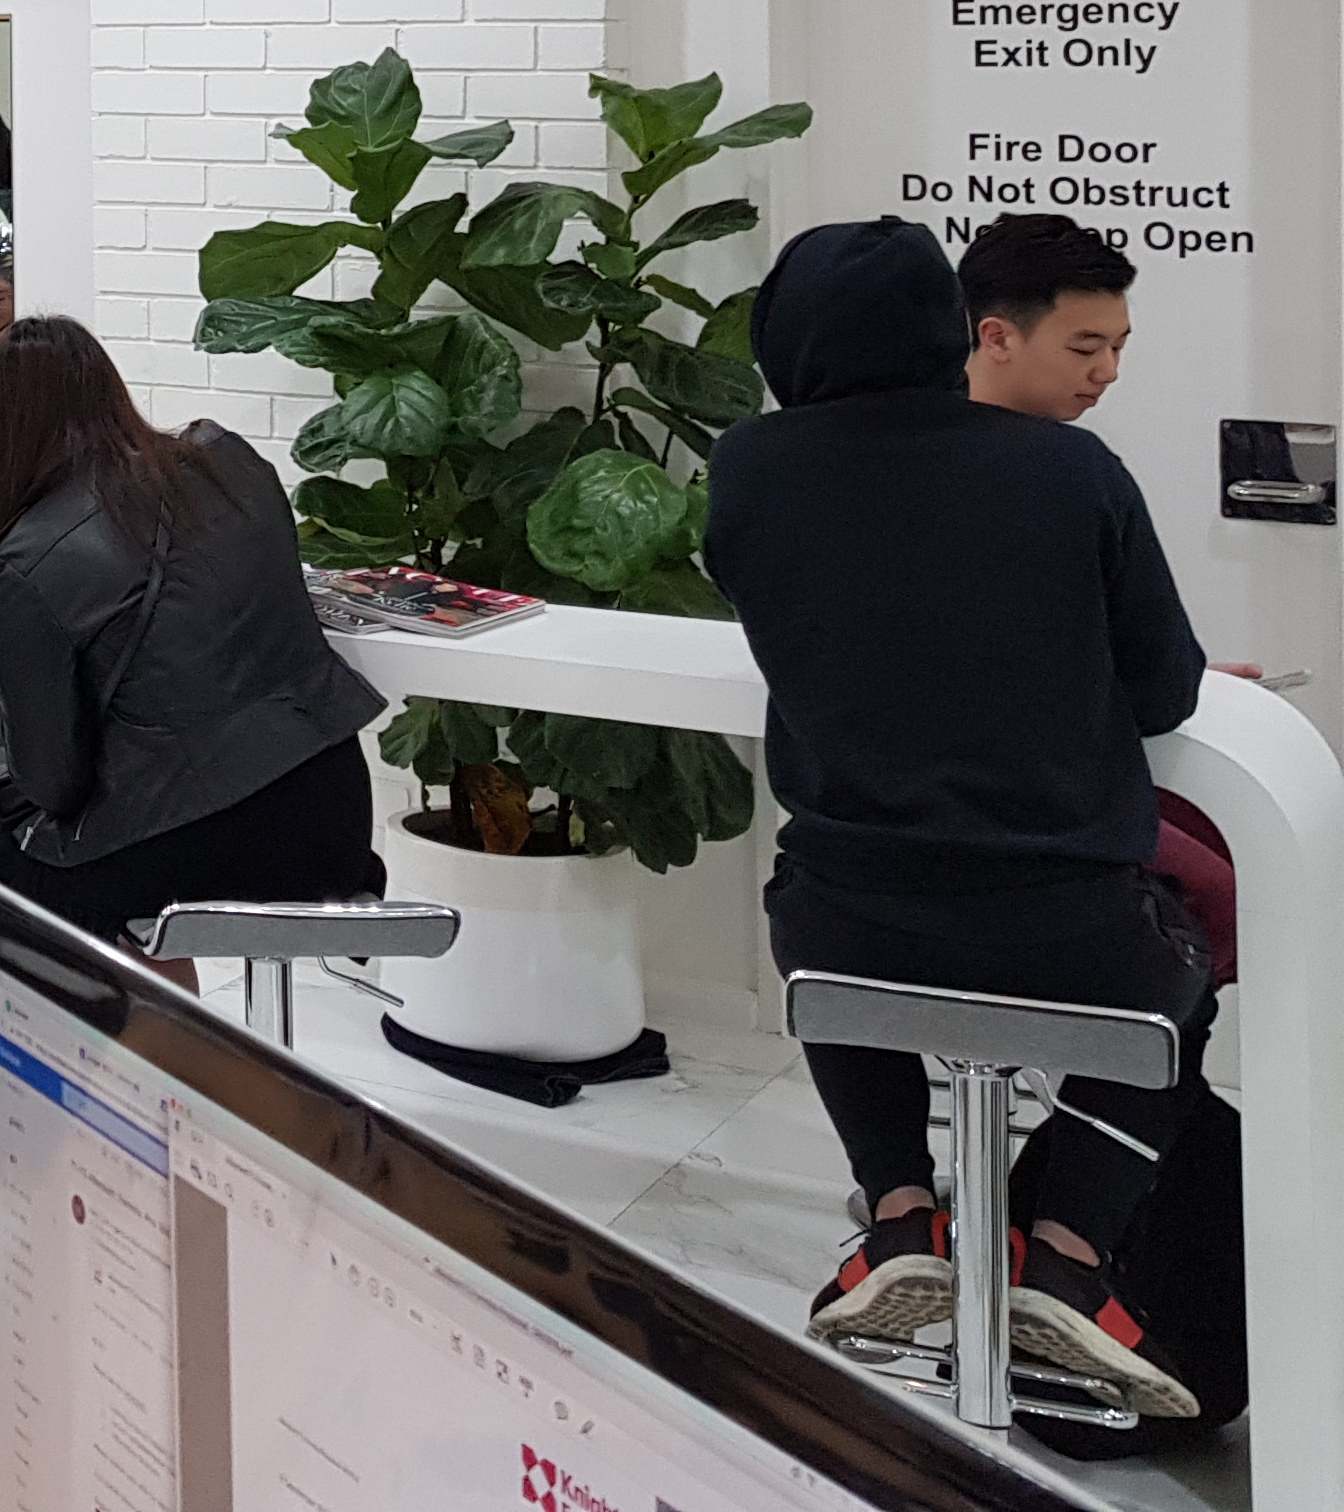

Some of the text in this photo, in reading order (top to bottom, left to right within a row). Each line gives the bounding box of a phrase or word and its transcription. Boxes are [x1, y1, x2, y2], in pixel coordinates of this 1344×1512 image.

[974, 38, 1157, 73] Exit Only
[968, 133, 1157, 164] Fire Door
[902, 174, 1231, 209] Do Not Obstruct
[1143, 222, 1255, 258] Open
